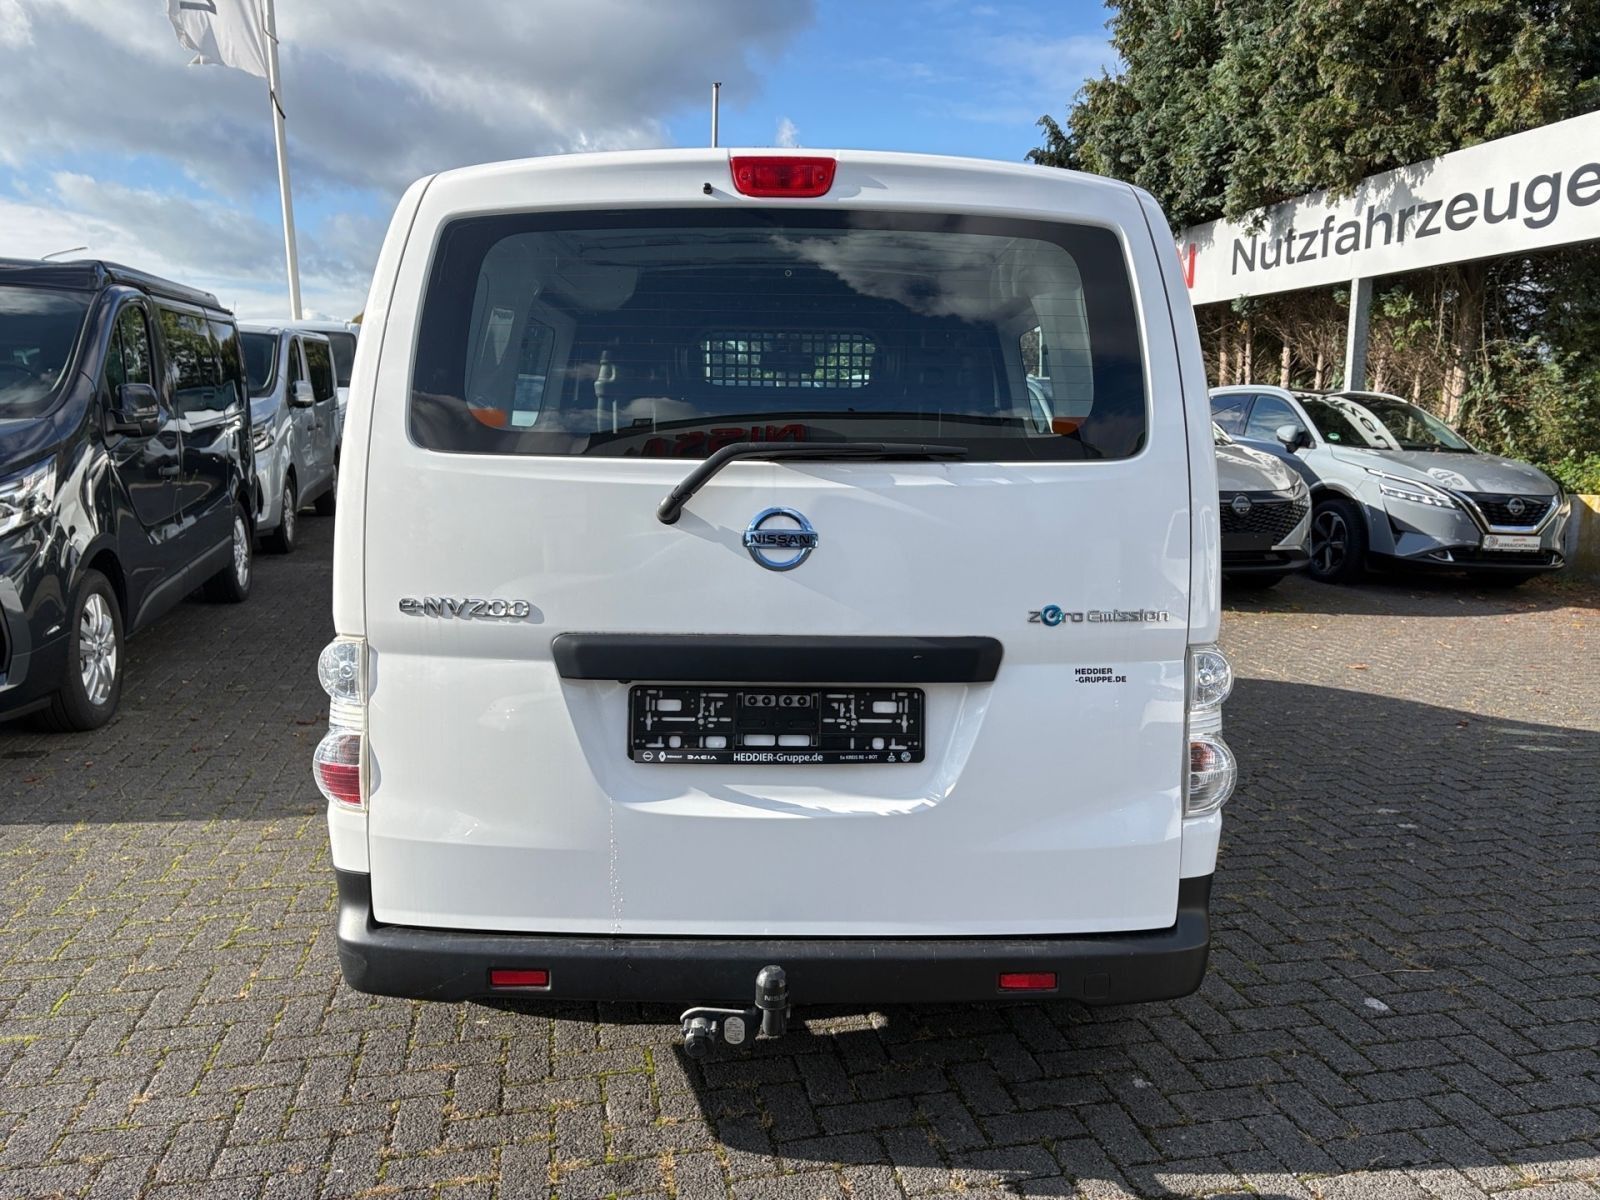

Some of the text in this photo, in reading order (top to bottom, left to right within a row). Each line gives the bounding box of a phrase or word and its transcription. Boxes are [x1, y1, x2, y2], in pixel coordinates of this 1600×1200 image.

[1231, 162, 1600, 275] Nutzfahrzeuge
[751, 534, 810, 544] NISSAN
[399, 597, 530, 617] e-NV200
[1087, 608, 1168, 622] Emission
[733, 753, 823, 763] HEDDIER-Gruppe.de
